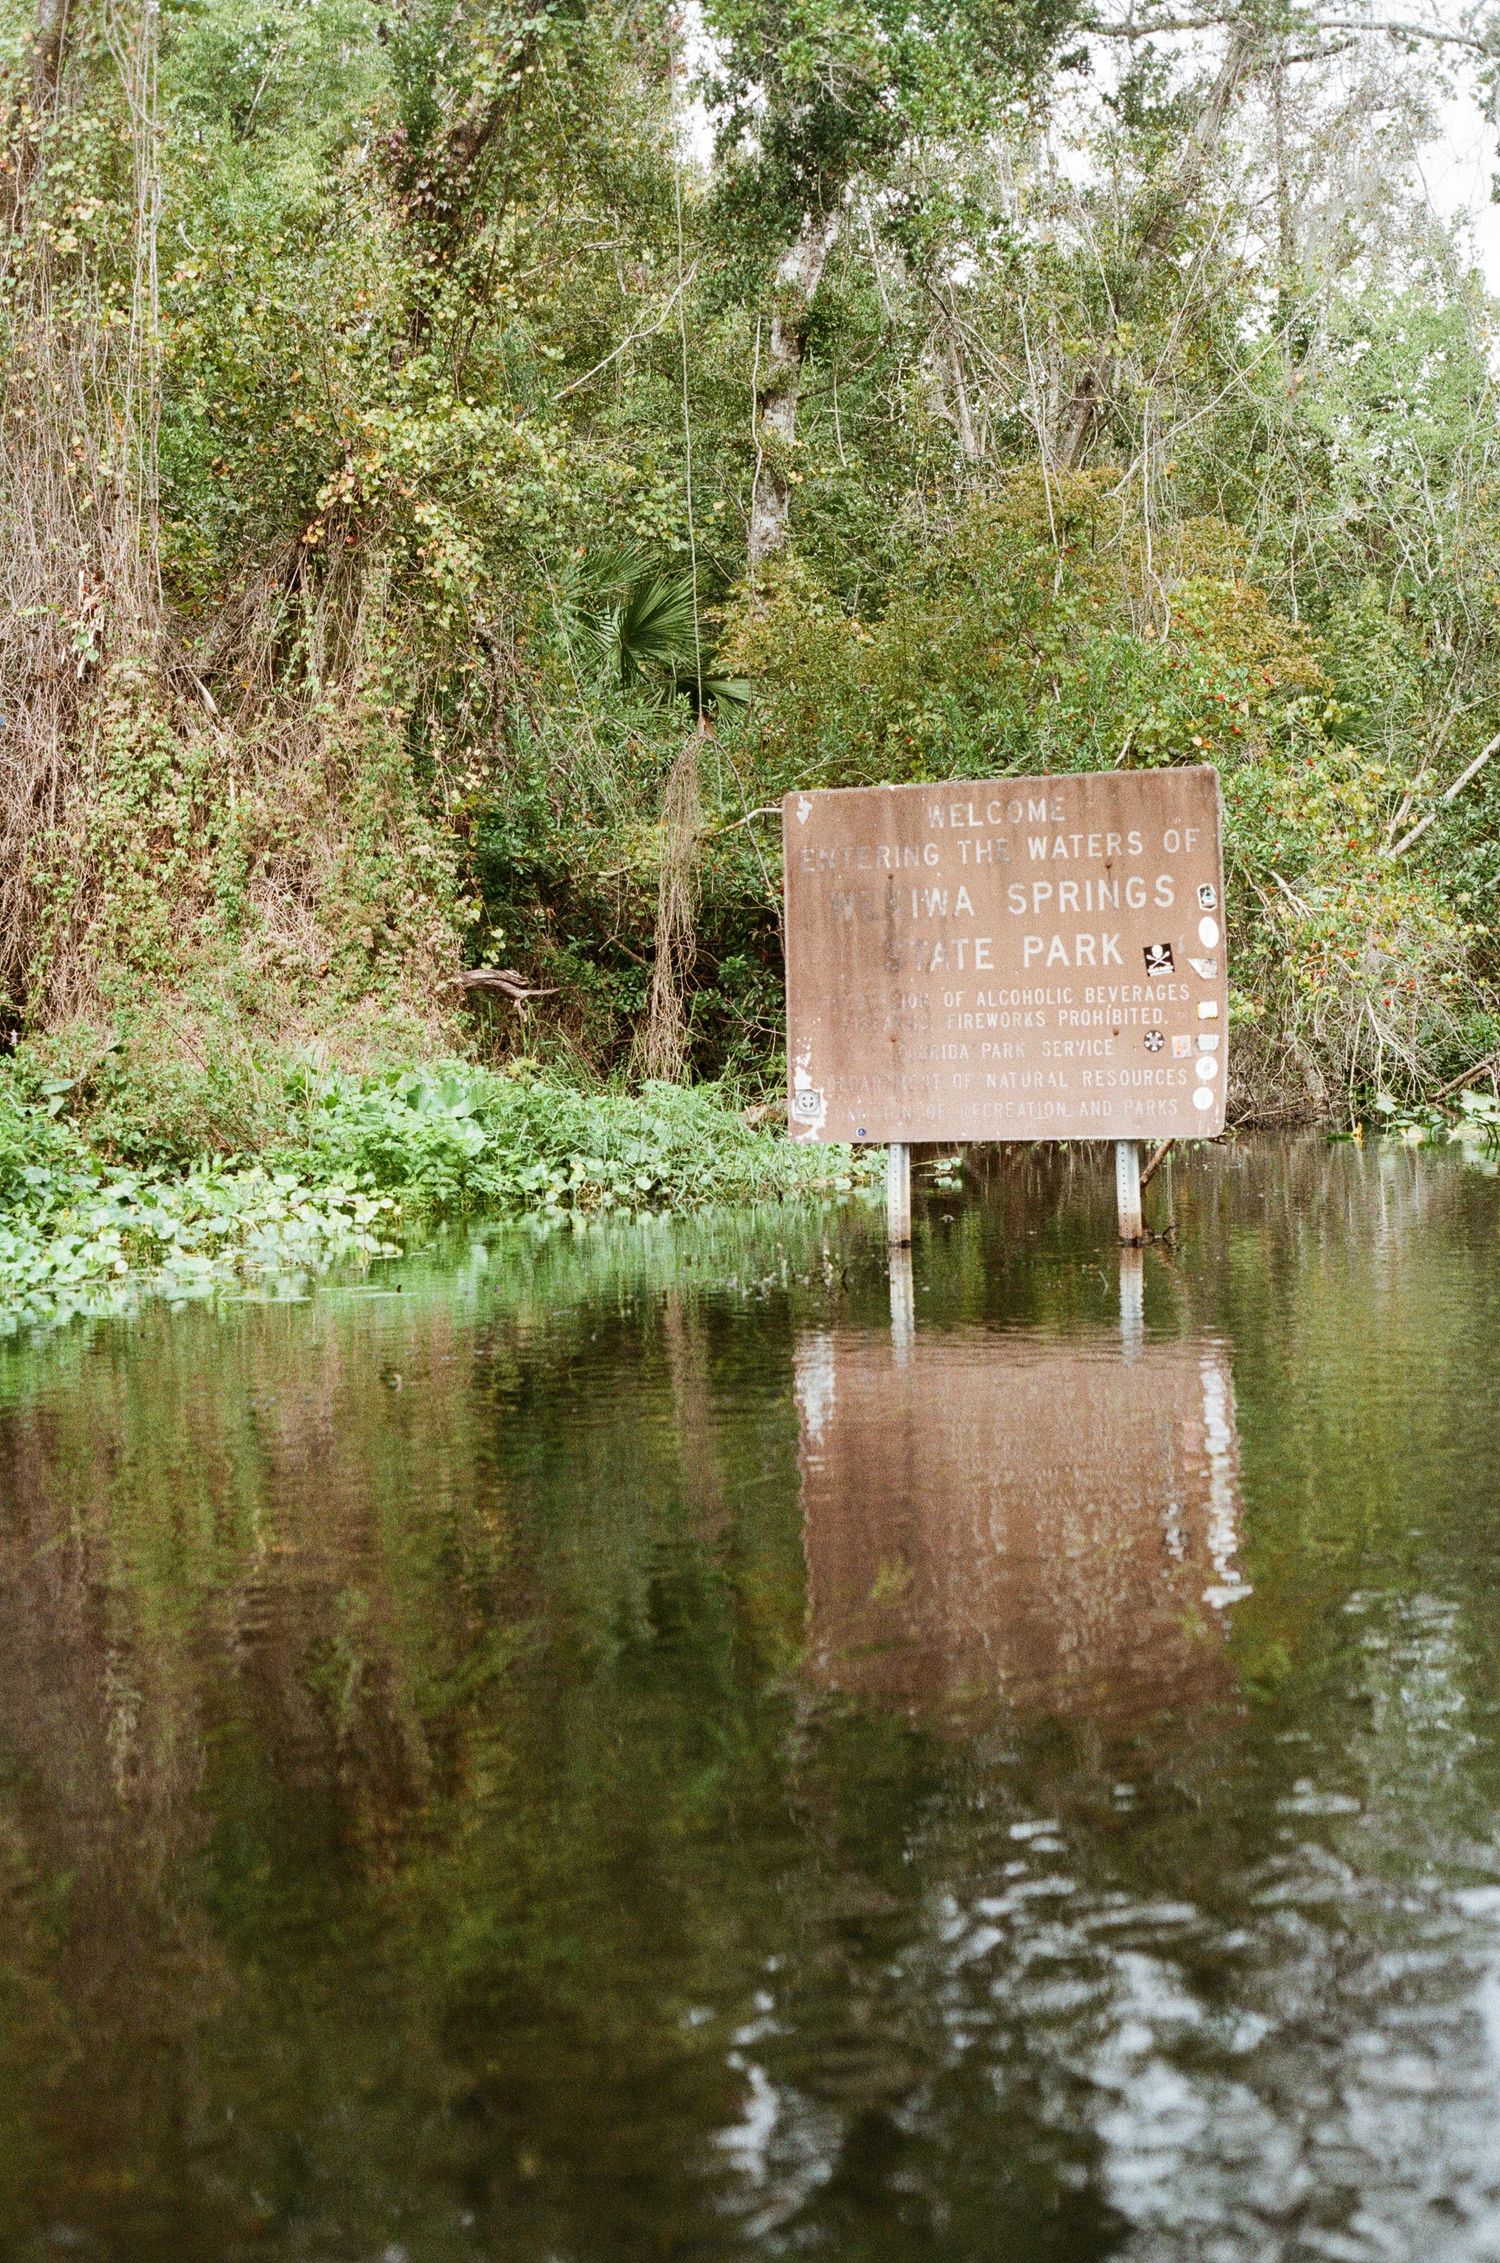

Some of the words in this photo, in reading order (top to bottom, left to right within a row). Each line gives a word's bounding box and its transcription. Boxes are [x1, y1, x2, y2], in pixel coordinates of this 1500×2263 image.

[928, 799, 1066, 828] WELCOME
[801, 842, 940, 873] ENTERING
[957, 838, 1013, 864] THE
[1028, 830, 1144, 860] WATERS
[1163, 828, 1200, 853] OF
[1007, 874, 1176, 915] SPRINGS
[1023, 933, 1124, 968] PARK
[943, 990, 964, 1008] OF
[976, 988, 1073, 1006] ALCOHOLIC
[1085, 983, 1190, 1003] BEVERAGES
[947, 1010, 1046, 1030] FIREWORKS
[1058, 1006, 1169, 1027] PROHIBITED.
[981, 1042, 1026, 1058] PARK
[1042, 1039, 1115, 1058] SERVICE
[951, 1073, 973, 1089] OF
[986, 1071, 1068, 1090] NATURAL
[1083, 1068, 1188, 1088] RESOURCES
[1079, 1099, 1113, 1117] AND
[1124, 1098, 1178, 1116] PARKS
